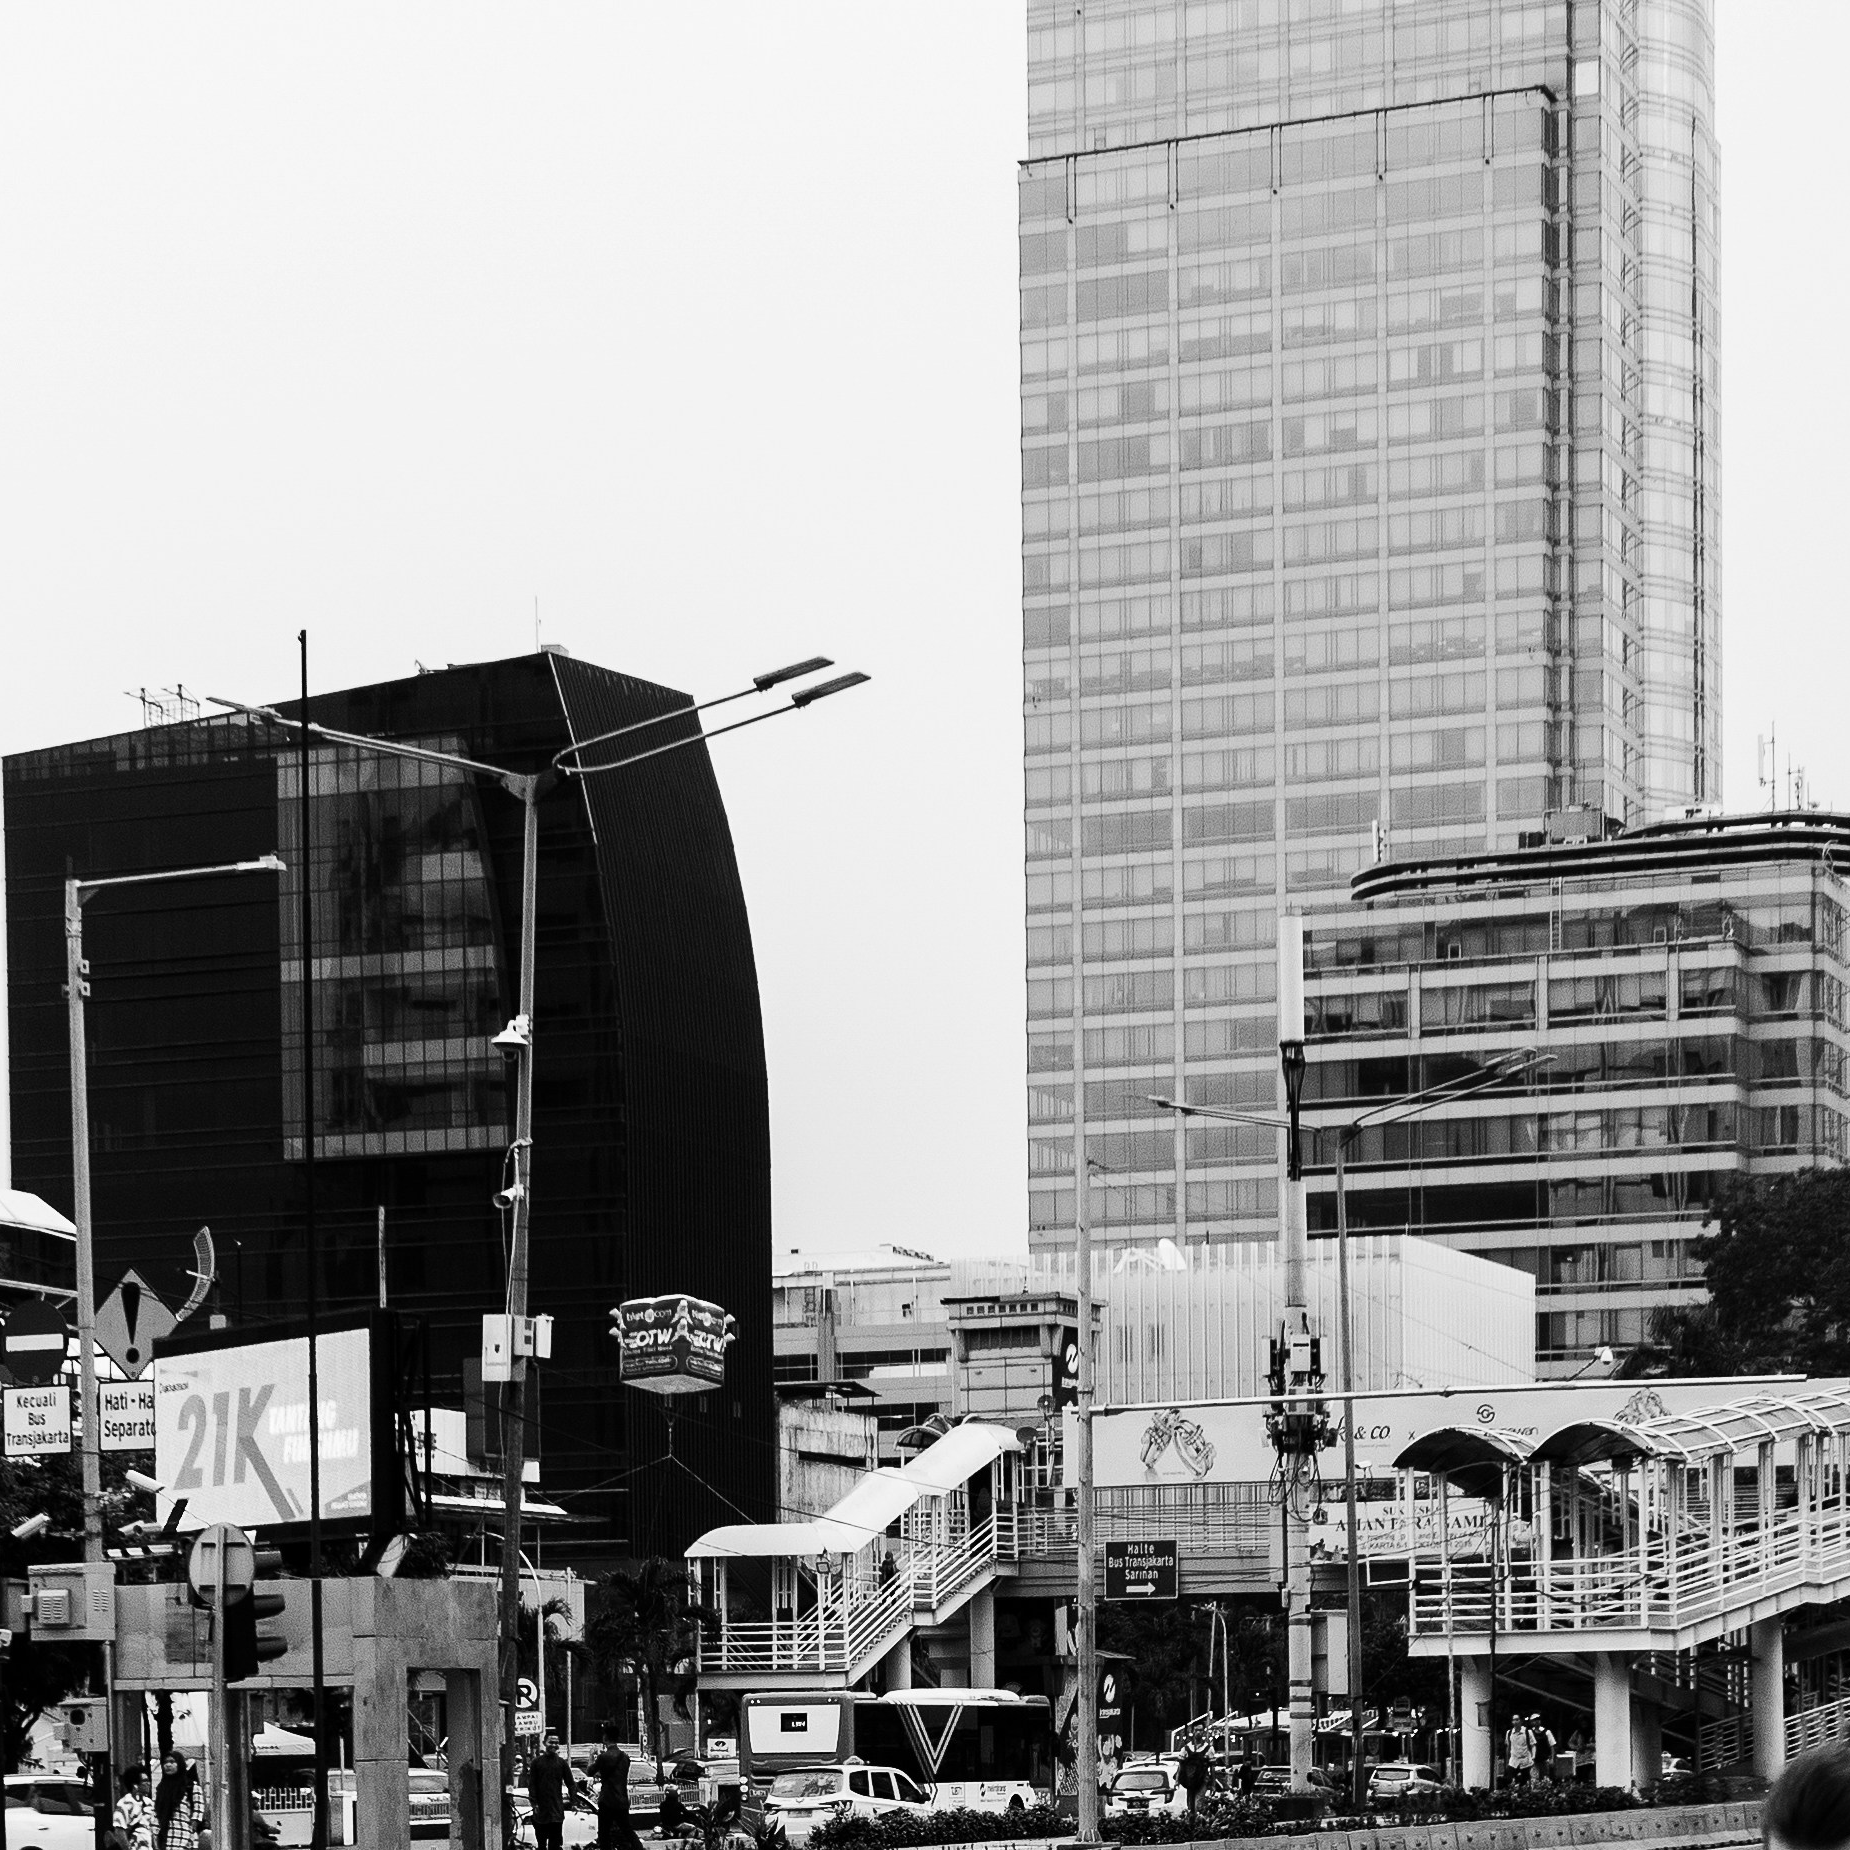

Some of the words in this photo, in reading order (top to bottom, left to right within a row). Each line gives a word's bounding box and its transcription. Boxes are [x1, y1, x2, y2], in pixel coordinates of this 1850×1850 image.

[16, 1392, 57, 1409] Kecuali
[105, 1391, 128, 1411] Hati
[139, 1390, 154, 1410] Ha
[28, 1412, 47, 1426] Bus
[6, 1430, 69, 1449] Transjakarta
[173, 1384, 295, 1521] 21K
[1336, 1509, 1384, 1531] AIAN
[1127, 1542, 1155, 1555] Halte
[1109, 1556, 1123, 1568] Bus
[1125, 1555, 1174, 1569] Transjakarta
